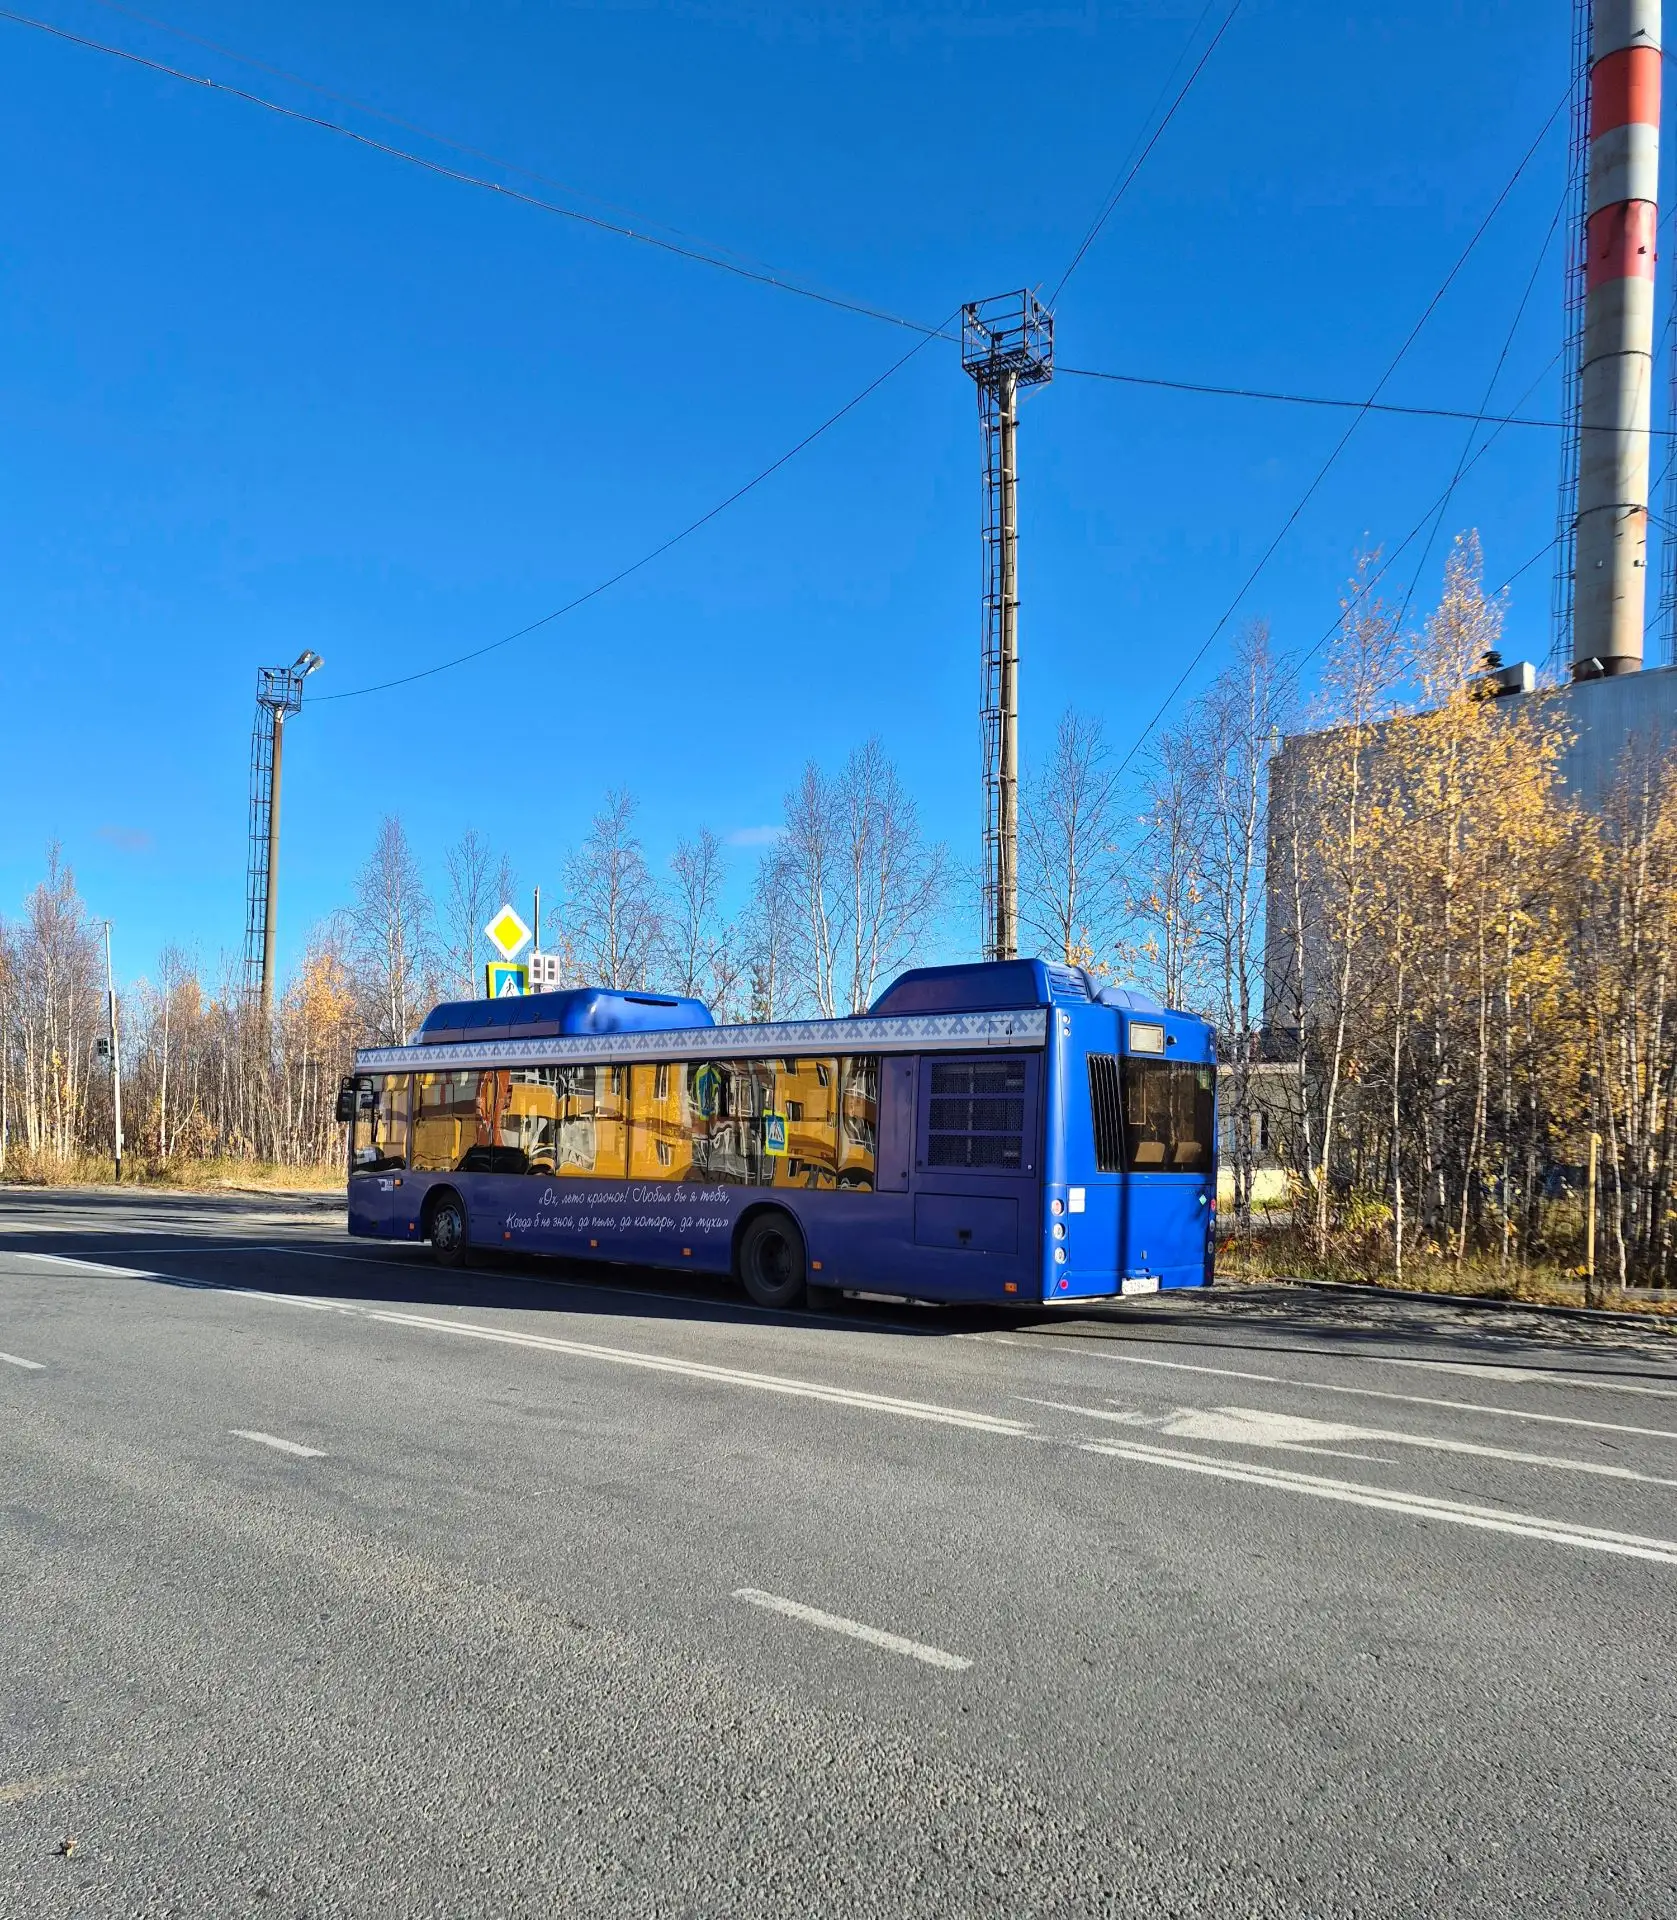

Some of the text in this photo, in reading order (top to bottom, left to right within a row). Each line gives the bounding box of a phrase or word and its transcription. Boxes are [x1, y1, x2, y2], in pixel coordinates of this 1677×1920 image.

[562, 1192, 585, 1204] лето
[632, 1185, 672, 1204] Любил
[674, 1185, 687, 1203] бы
[689, 1191, 698, 1202] я
[700, 1185, 730, 1204] тебя,
[506, 1211, 532, 1233] Когда
[552, 1216, 575, 1229] зной,
[577, 1216, 589, 1232] да
[591, 1216, 617, 1230] пыль,
[620, 1216, 632, 1232] да
[634, 1216, 677, 1232] комары,
[680, 1216, 692, 1232] да
